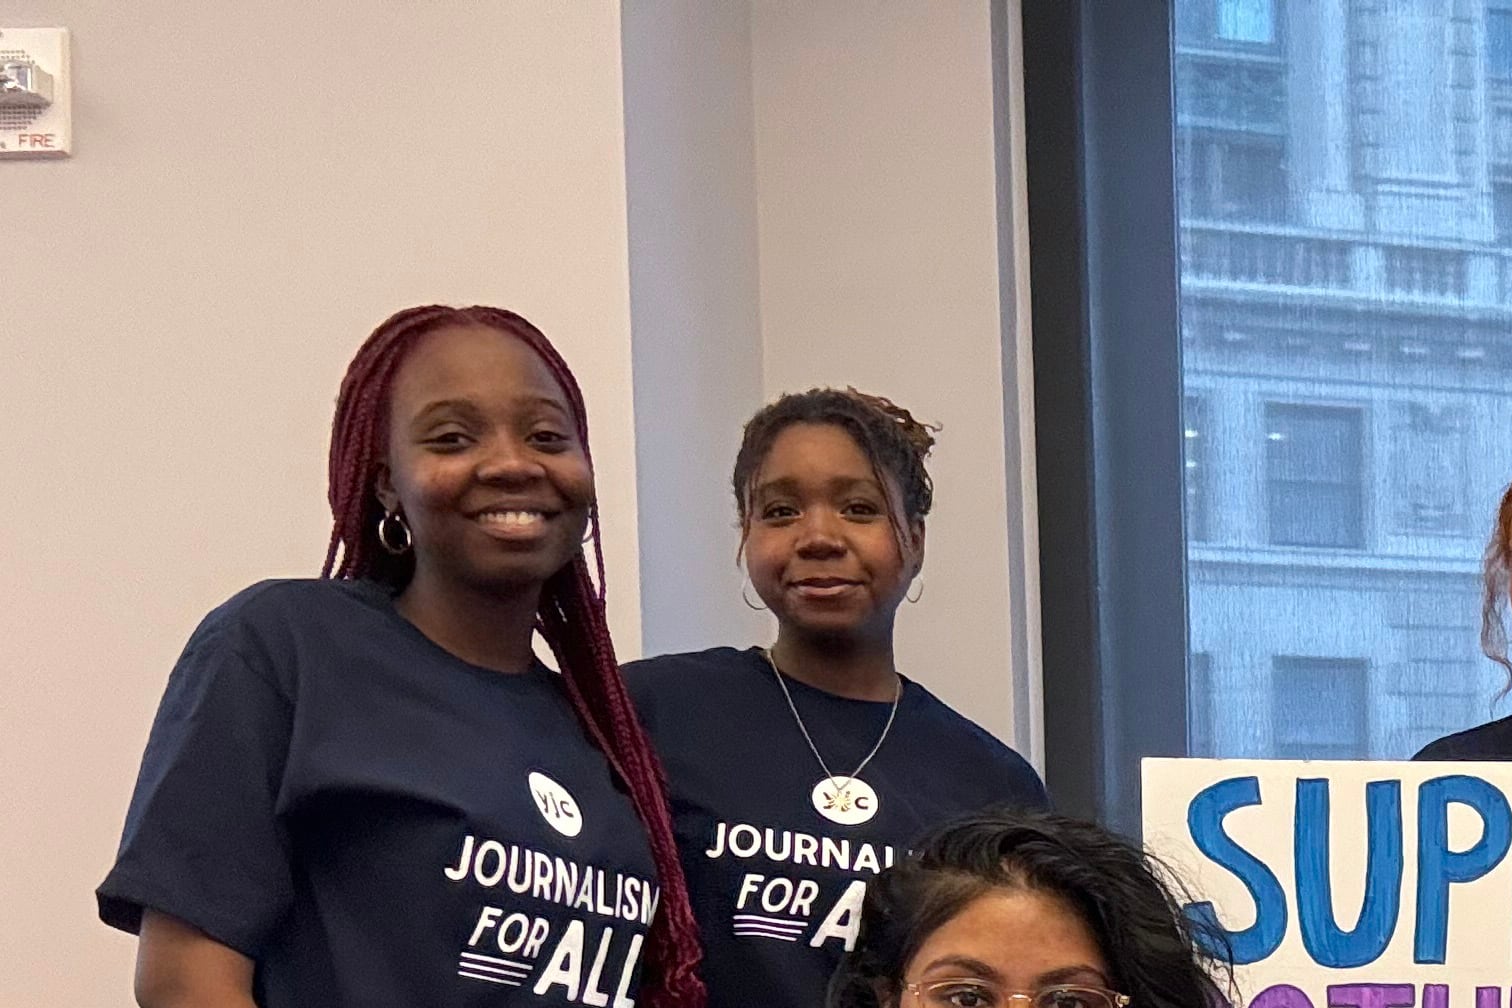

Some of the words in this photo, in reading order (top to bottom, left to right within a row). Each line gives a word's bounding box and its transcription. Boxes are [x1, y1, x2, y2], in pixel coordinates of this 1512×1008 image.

[18, 133, 56, 148] FIRE
[736, 873, 819, 917] FOR
[468, 907, 549, 959] FOR
